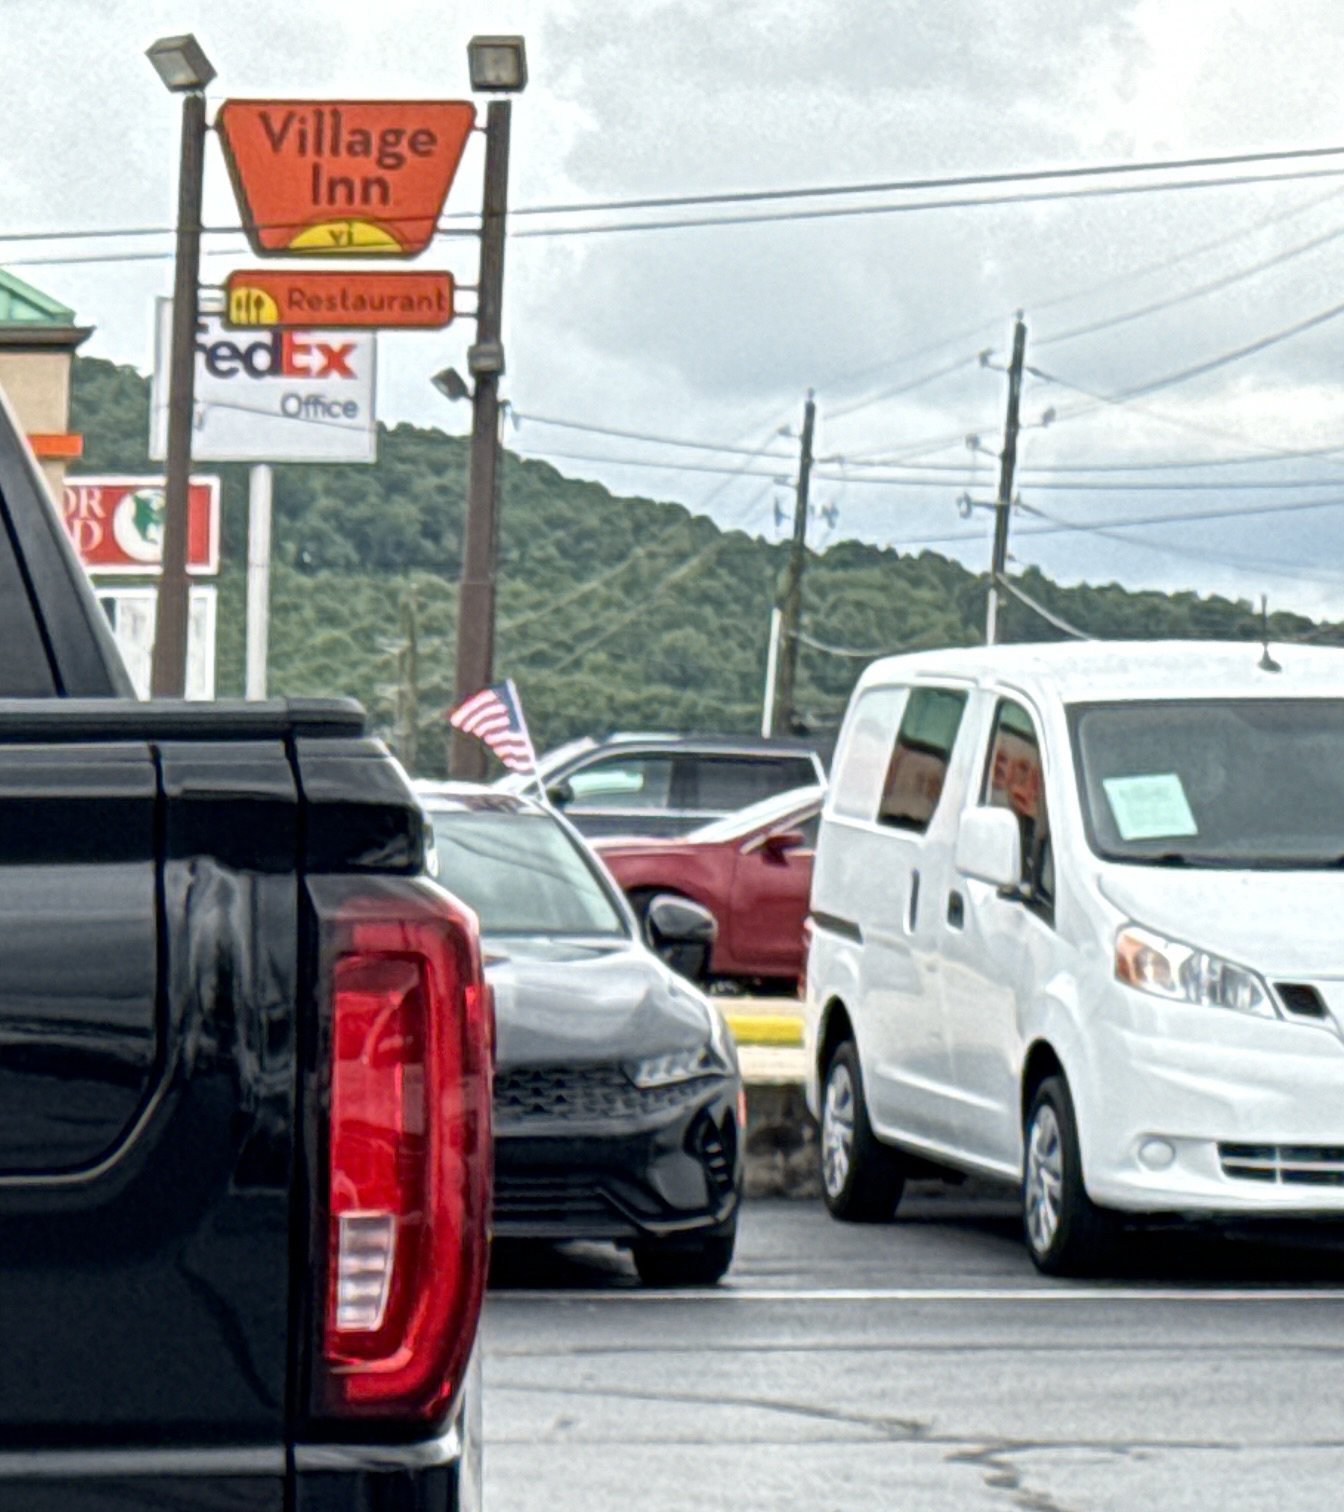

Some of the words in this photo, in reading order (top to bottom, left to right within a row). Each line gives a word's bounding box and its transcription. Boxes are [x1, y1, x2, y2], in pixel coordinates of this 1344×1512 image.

[258, 108, 438, 170] Village
[311, 162, 391, 206] Inn
[287, 287, 446, 311] Restaurant
[195, 324, 358, 380] edEx
[280, 392, 359, 419] Office
